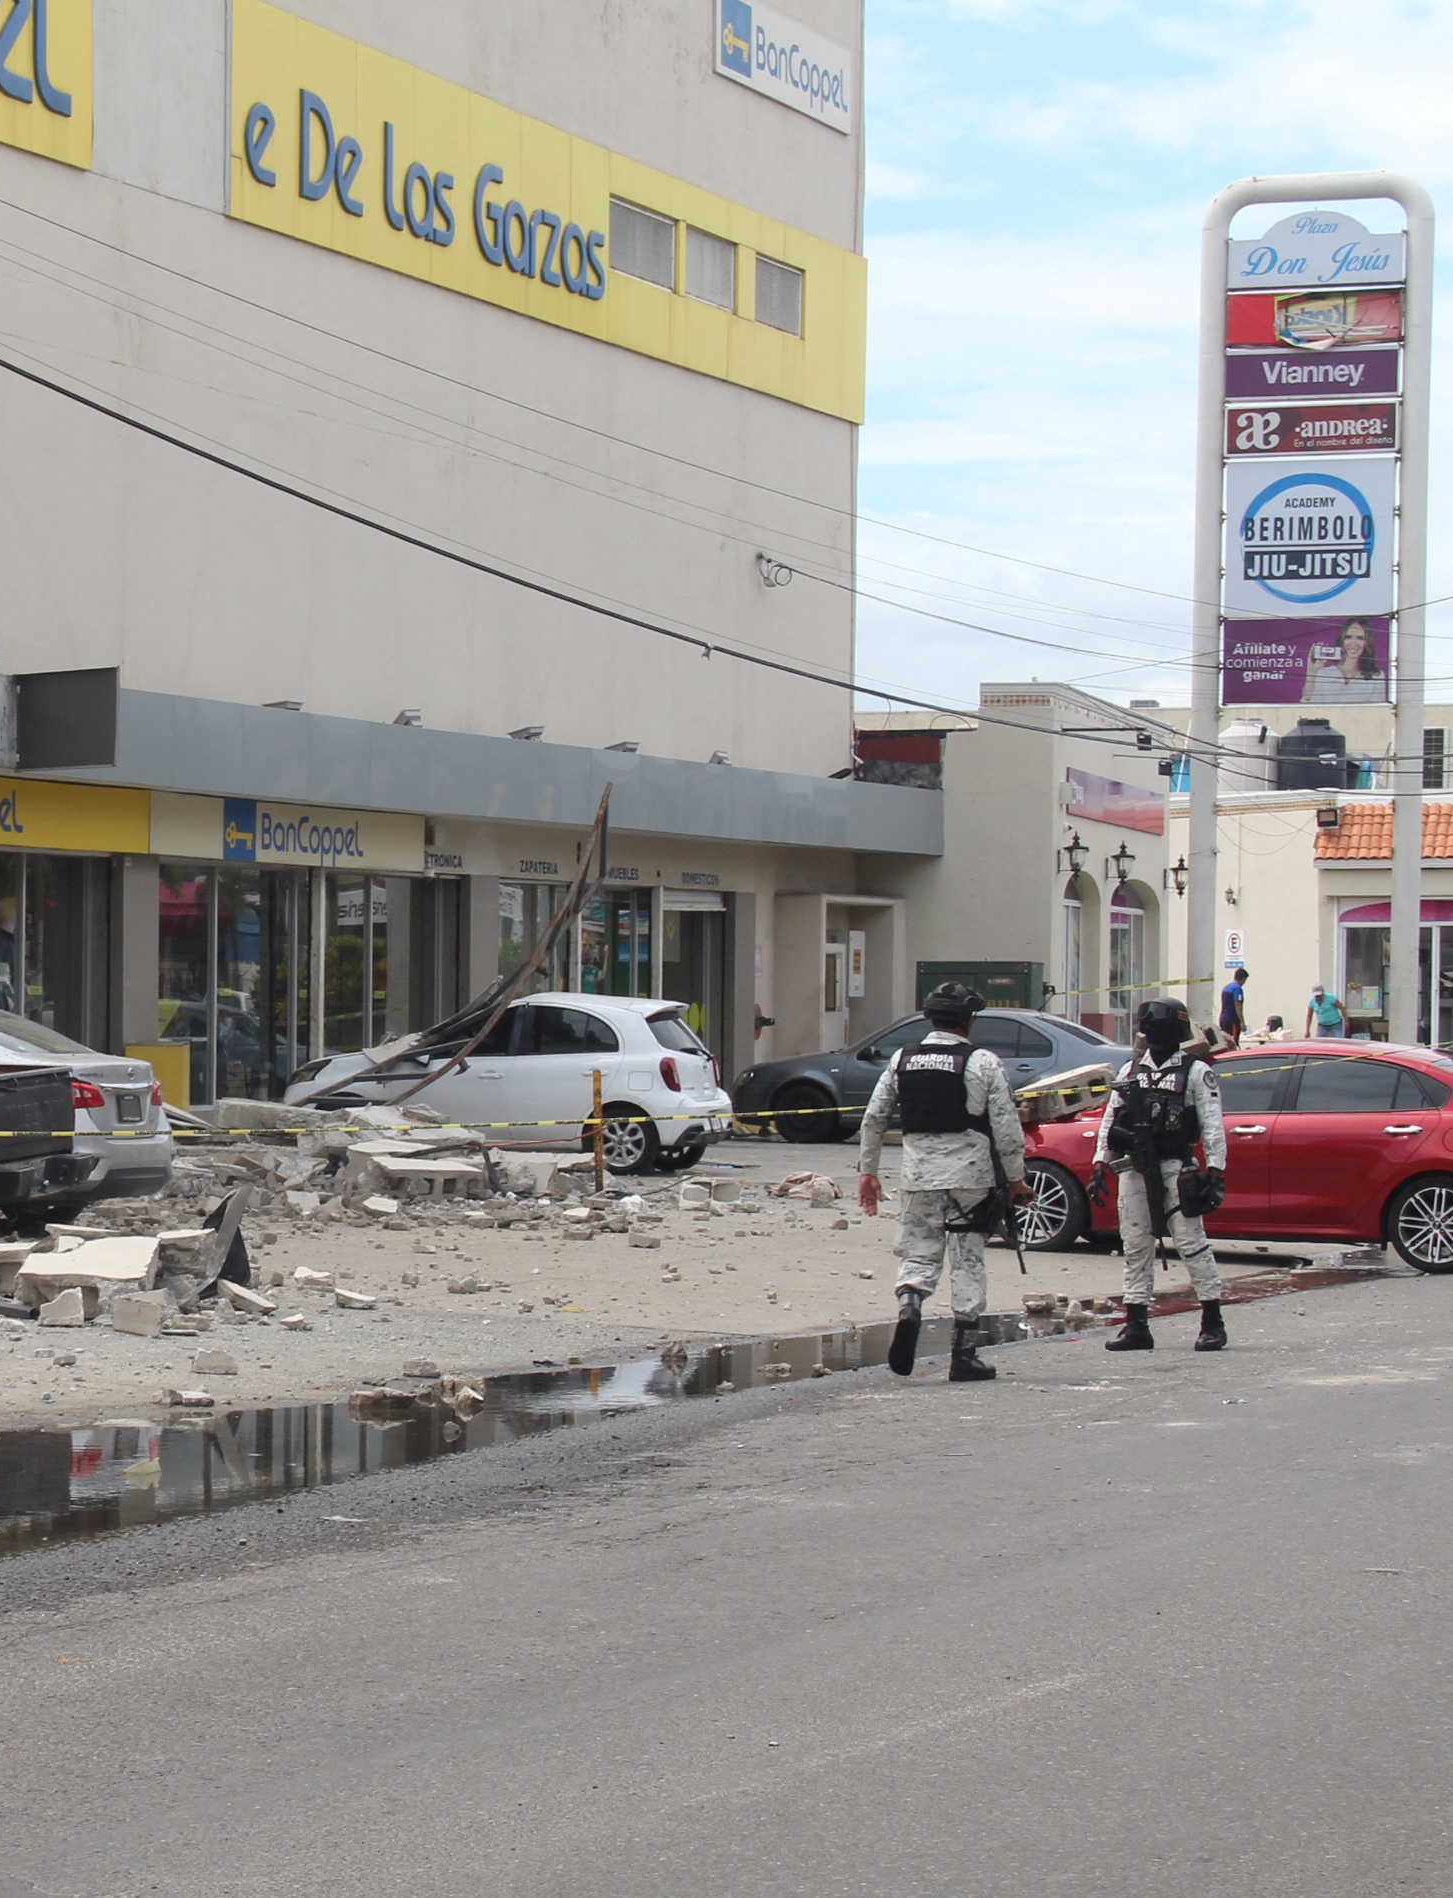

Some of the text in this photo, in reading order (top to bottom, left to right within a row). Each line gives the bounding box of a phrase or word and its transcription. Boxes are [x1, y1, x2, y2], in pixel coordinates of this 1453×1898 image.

[756, 25, 848, 113] BanCoppel
[299, 88, 364, 217] De
[474, 163, 606, 300] Garzas
[1292, 216, 1341, 235] Plaza
[1240, 242, 1391, 282] Don Jesús
[1262, 361, 1365, 387] Vianney
[1294, 436, 1394, 447] En el nombre del diseño
[1284, 497, 1336, 509] ACADEMY
[1245, 515, 1373, 541] BERIMBOLO
[1247, 552, 1368, 577] JIU-JITSU
[1288, 645, 1297, 657] y
[1226, 656, 1303, 668] comienza a
[1243, 670, 1286, 683] ganar
[261, 812, 363, 867] BanCoppel
[520, 860, 558, 875] ZAPATERIA
[1231, 937, 1237, 949] E
[910, 1053, 954, 1063] GUARDIA
[906, 1061, 955, 1073] NACIONAL
